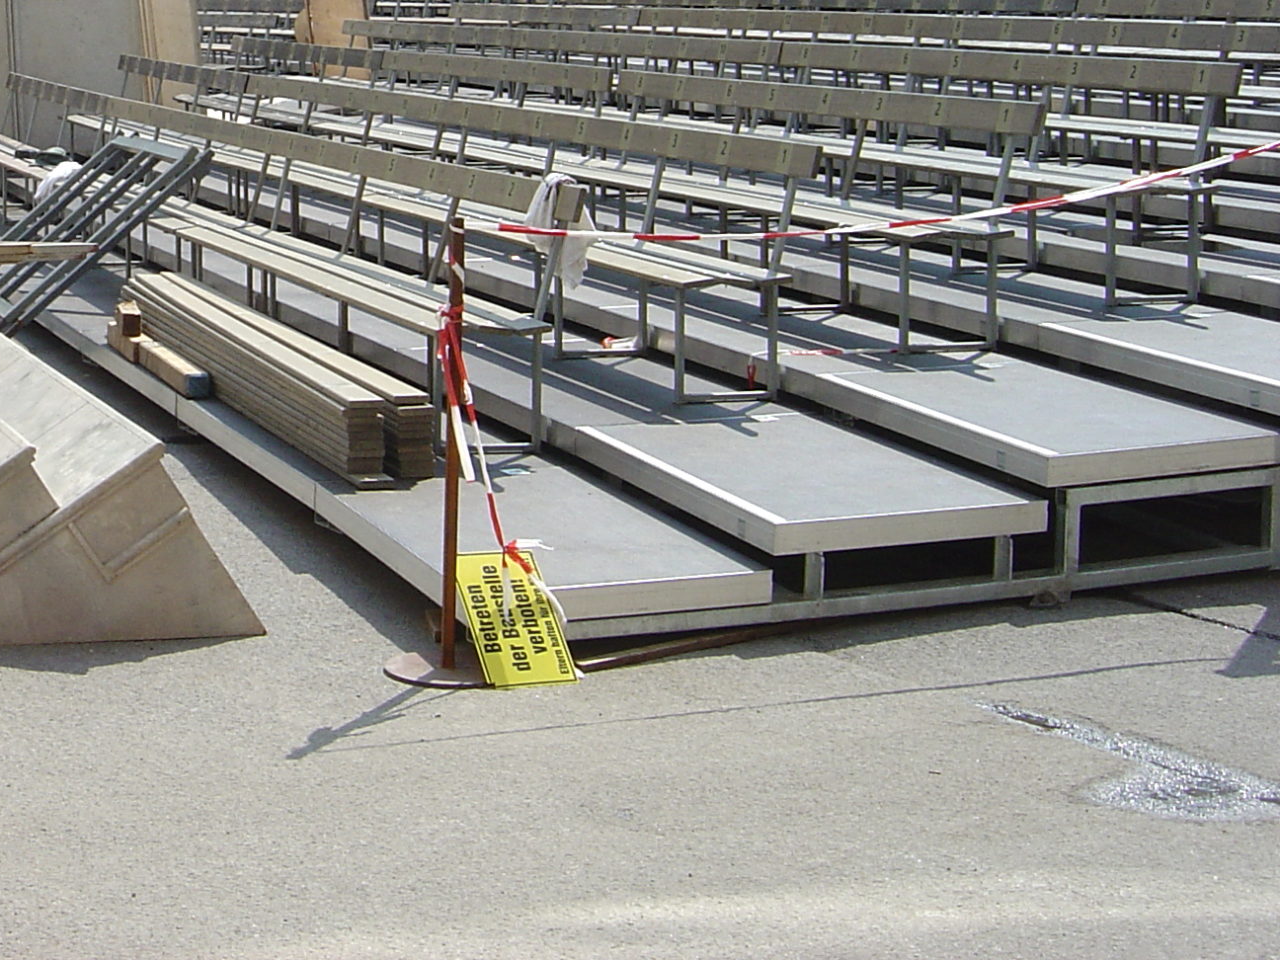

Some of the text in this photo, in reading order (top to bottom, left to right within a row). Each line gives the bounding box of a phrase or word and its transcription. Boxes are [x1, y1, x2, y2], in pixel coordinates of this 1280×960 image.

[1130, 65, 1137, 79] 2
[934, 102, 941, 117] 2
[721, 141, 728, 156] 2
[467, 584, 502, 653] Betreten
[483, 565, 531, 672] der Baustelle
[510, 579, 548, 654] verboten!
[544, 621, 560, 648] haften
[555, 650, 569, 674] Eltern
